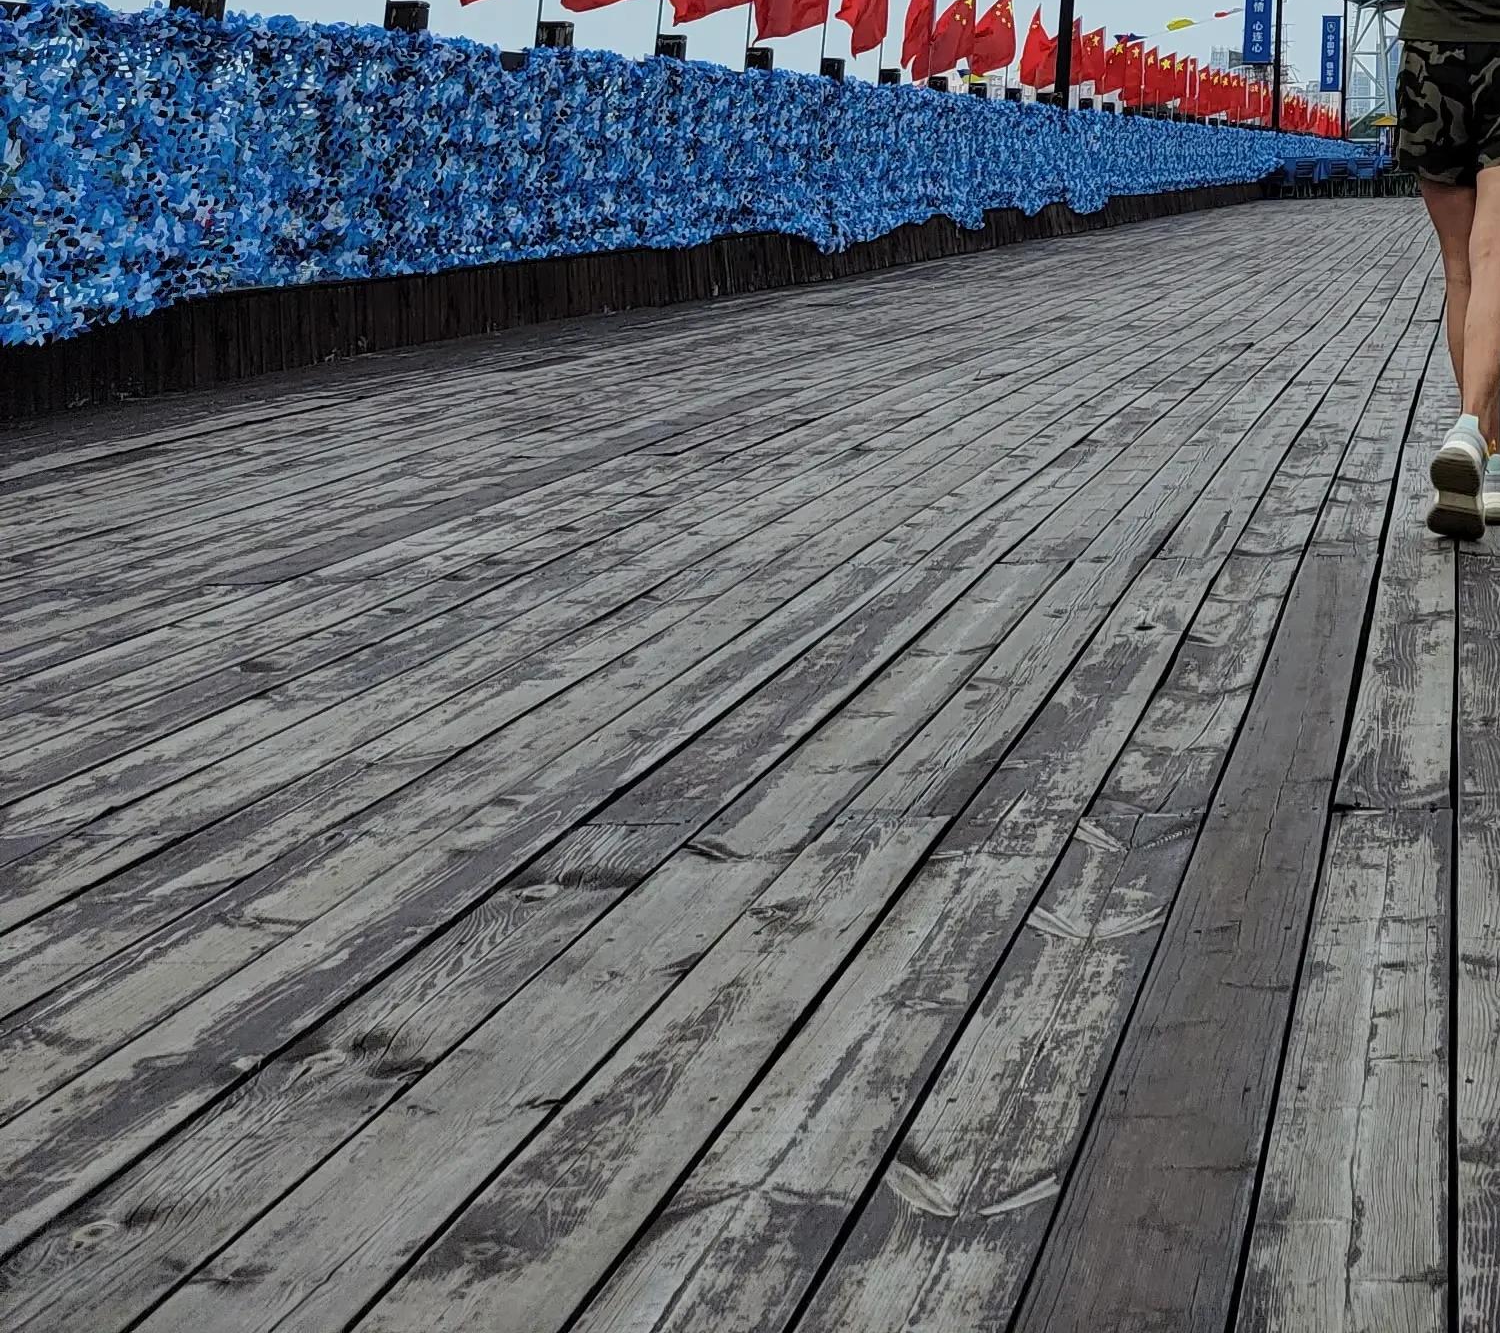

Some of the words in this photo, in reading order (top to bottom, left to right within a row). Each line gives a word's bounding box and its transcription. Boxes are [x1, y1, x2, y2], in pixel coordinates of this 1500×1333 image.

[1251, 20, 1264, 54] 心连心
[1326, 34, 1335, 57] 中国梦
